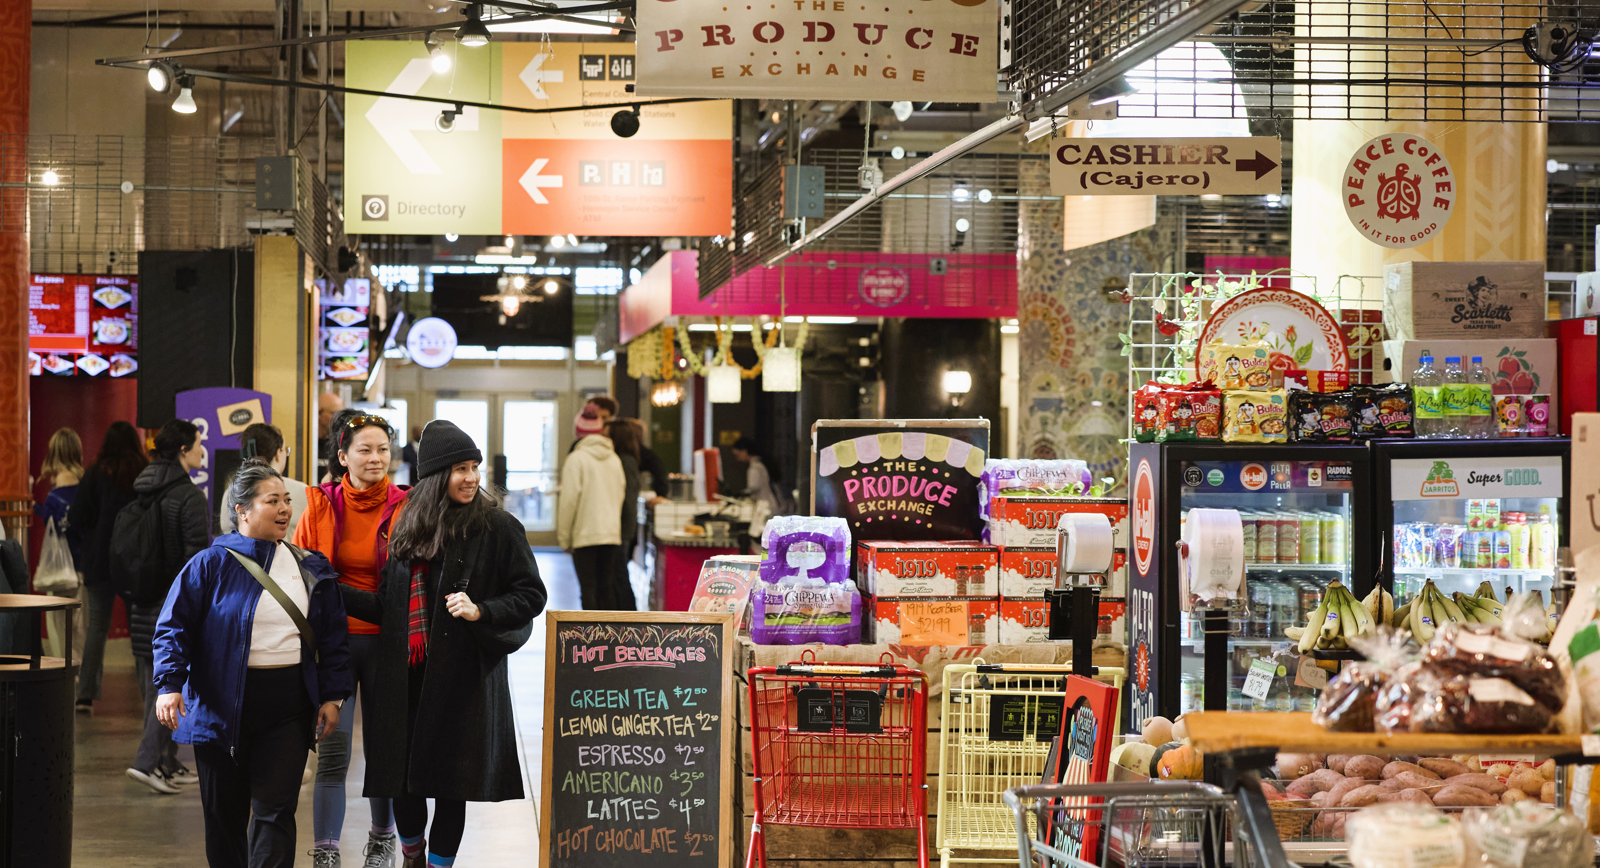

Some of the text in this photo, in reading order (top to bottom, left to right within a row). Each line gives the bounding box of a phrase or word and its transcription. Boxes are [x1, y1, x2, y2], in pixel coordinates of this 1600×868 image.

[794, 0, 844, 11] THE
[655, 20, 980, 57] PRODUCE
[711, 62, 926, 82] EXCHANGE
[1056, 145, 1231, 165] CASHIER
[1080, 170, 1210, 190] (Cajero)
[1347, 137, 1395, 208] PEACE
[397, 201, 466, 219] Directory
[1359, 219, 1437, 243] IN IT FOR GOOD
[883, 462, 916, 472] THE
[997, 470, 1006, 479] 24
[1271, 464, 1291, 476] ALTA
[1327, 466, 1346, 475] RADIO
[1467, 469, 1542, 487] Super GOOD.
[844, 475, 958, 508] PRODUCE
[1424, 486, 1456, 494] JARRITOS
[857, 500, 935, 517] EXCHANGE
[703, 565, 751, 582] NOW SHOWING
[895, 559, 939, 580] 1919
[764, 594, 774, 604] 24
[907, 603, 925, 616] 1919
[1132, 588, 1154, 654] ALTA
[572, 645, 706, 663] HOT BEVERAGES
[570, 689, 630, 709] GREEN
[633, 688, 669, 710] TEA
[560, 714, 607, 737] LEMON
[612, 714, 664, 737] GINGER
[664, 715, 695, 737] TEA
[578, 744, 666, 767] ESPRESSO
[562, 770, 663, 794] AMERICANO
[587, 797, 660, 822] LATTES
[557, 825, 593, 858] HOT
[596, 827, 677, 854] CHOCOLATE
